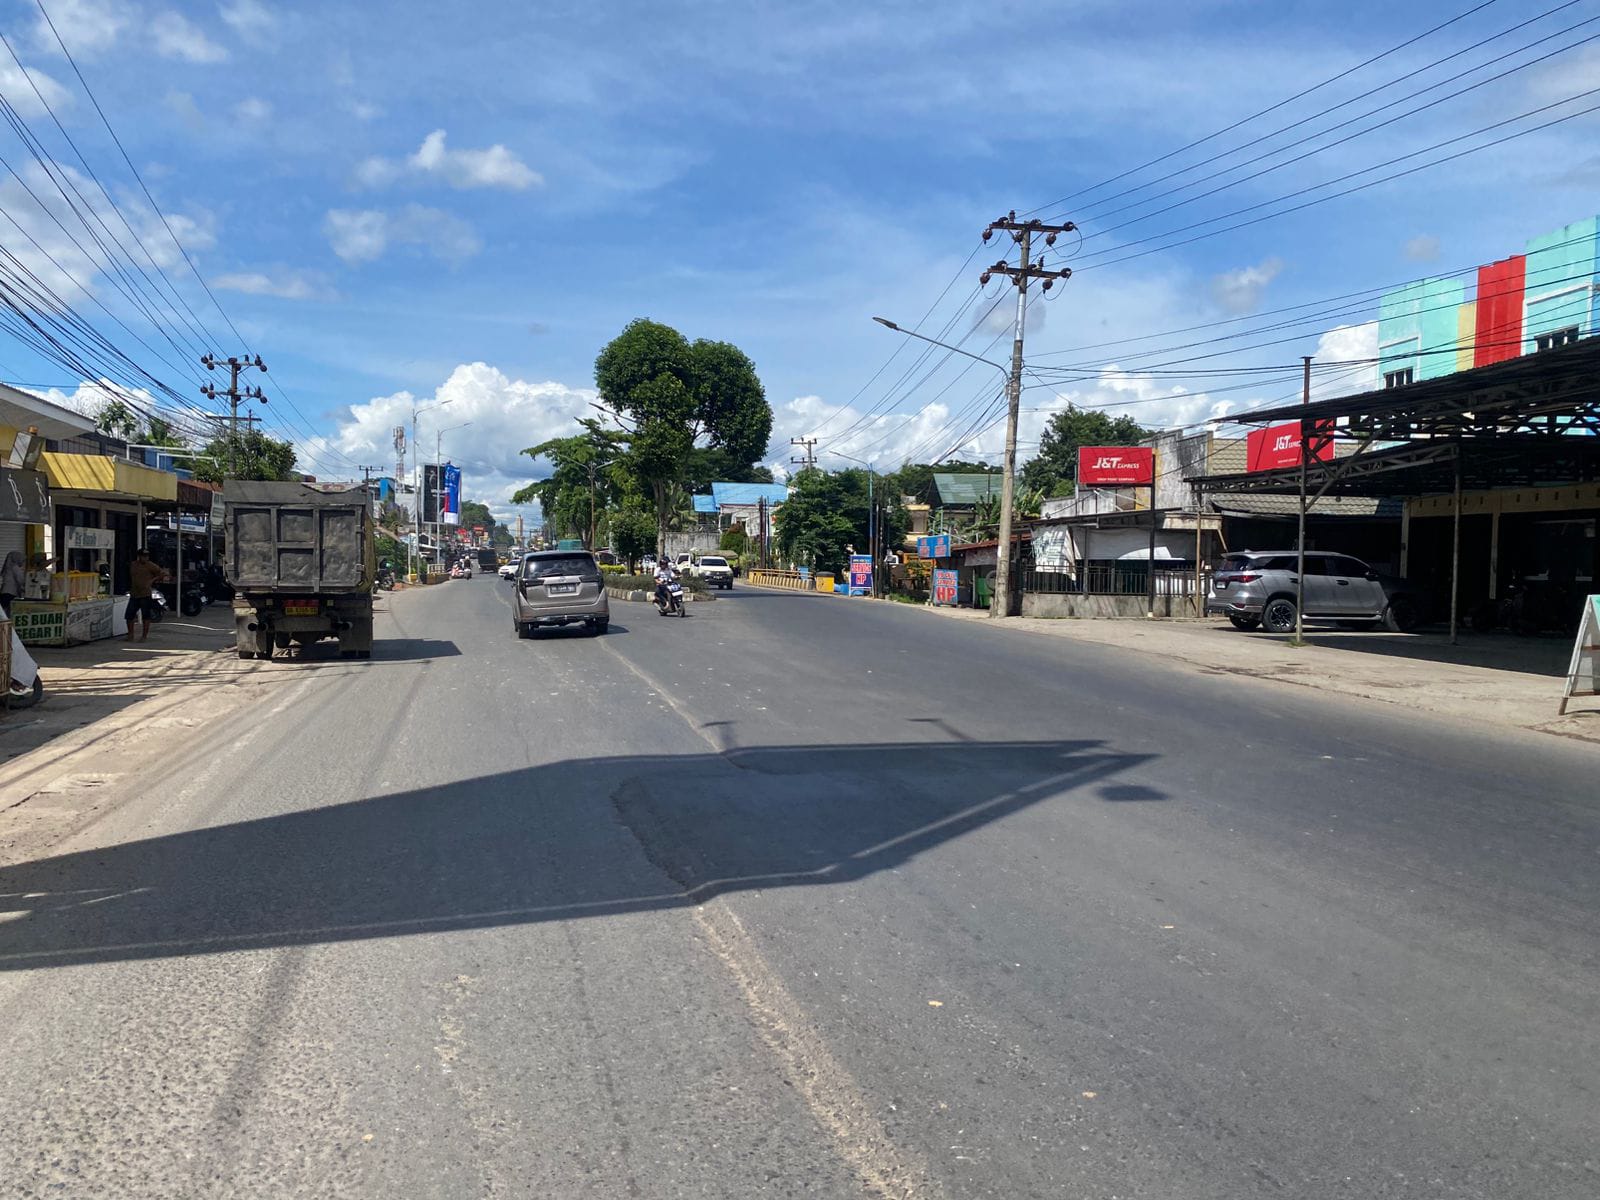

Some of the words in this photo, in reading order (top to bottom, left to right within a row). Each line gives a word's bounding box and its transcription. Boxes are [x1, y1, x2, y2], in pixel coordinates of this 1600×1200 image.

[1273, 435, 1292, 451] J&T
[1092, 457, 1122, 469] J&T
[855, 574, 867, 584] HP
[936, 586, 956, 602] HP
[15, 615, 29, 627] ES
[31, 613, 63, 626] BUAH
